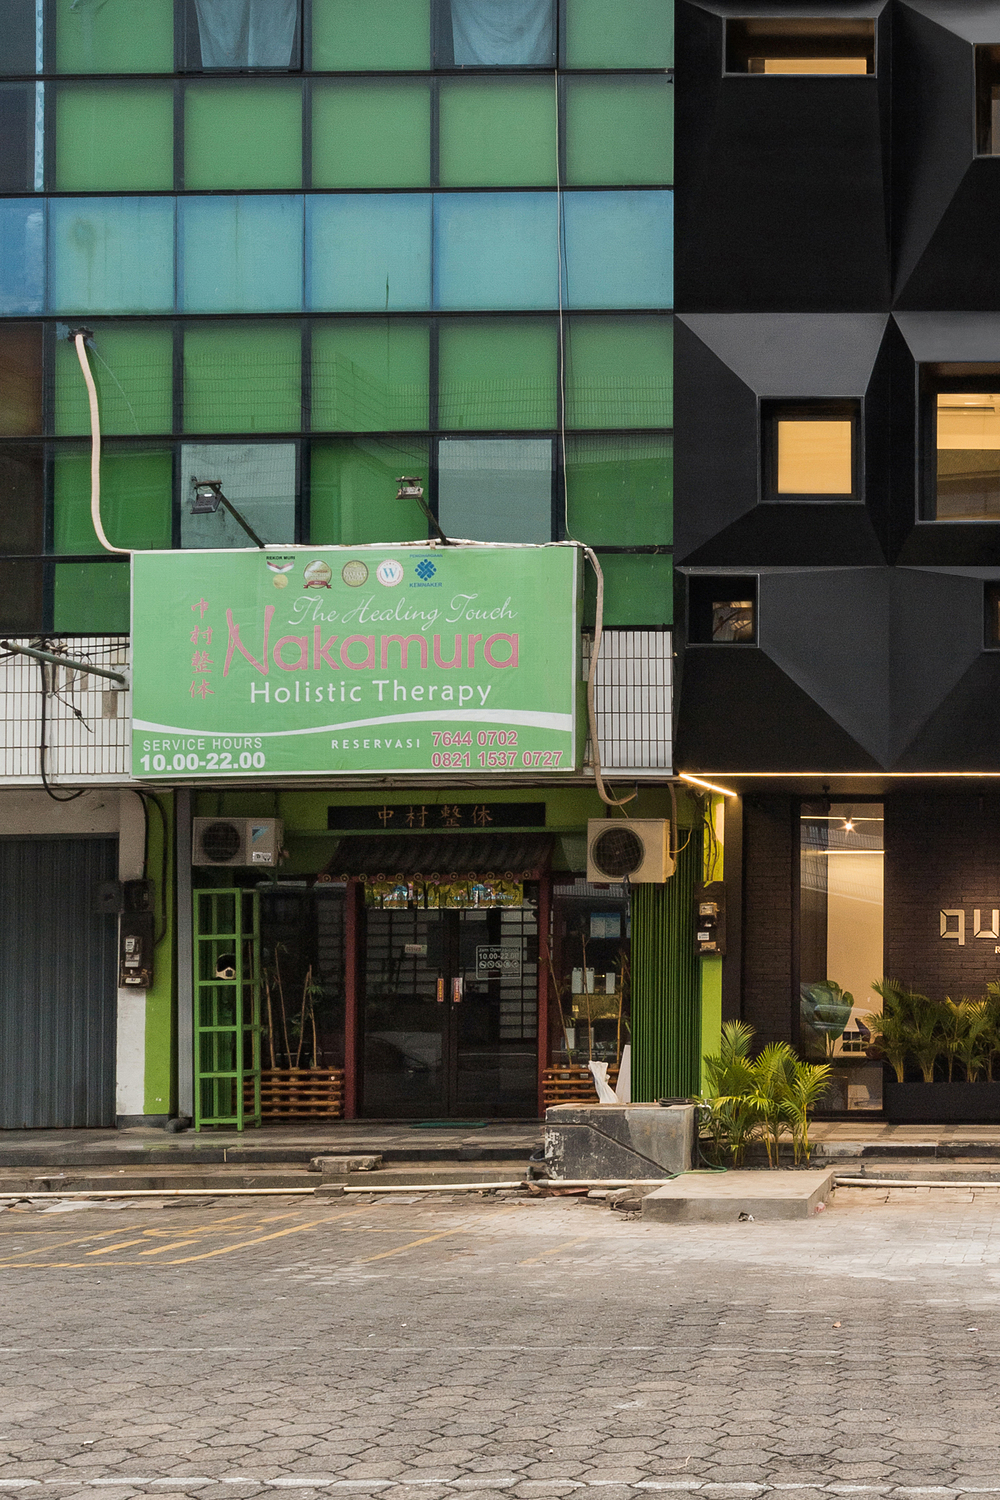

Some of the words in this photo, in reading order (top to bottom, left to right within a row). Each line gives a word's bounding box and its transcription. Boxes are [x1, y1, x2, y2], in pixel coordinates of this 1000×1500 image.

[288, 594, 338, 625] The
[342, 594, 442, 631] Healing
[446, 594, 518, 623] Touch
[223, 605, 520, 677] Nakamura
[250, 682, 363, 703] Holistic
[373, 679, 492, 706] Therapy
[143, 739, 206, 751] SERVICE
[212, 737, 263, 750] HOURS
[331, 738, 421, 749] RESERVASI
[432, 731, 472, 747] 7644
[477, 730, 518, 746] 0702
[140, 752, 266, 771] 10.00-22.00
[432, 752, 471, 767] 0821
[478, 751, 518, 767] 1537
[522, 750, 563, 766] 0727
[378, 805, 493, 828] 中村整体
